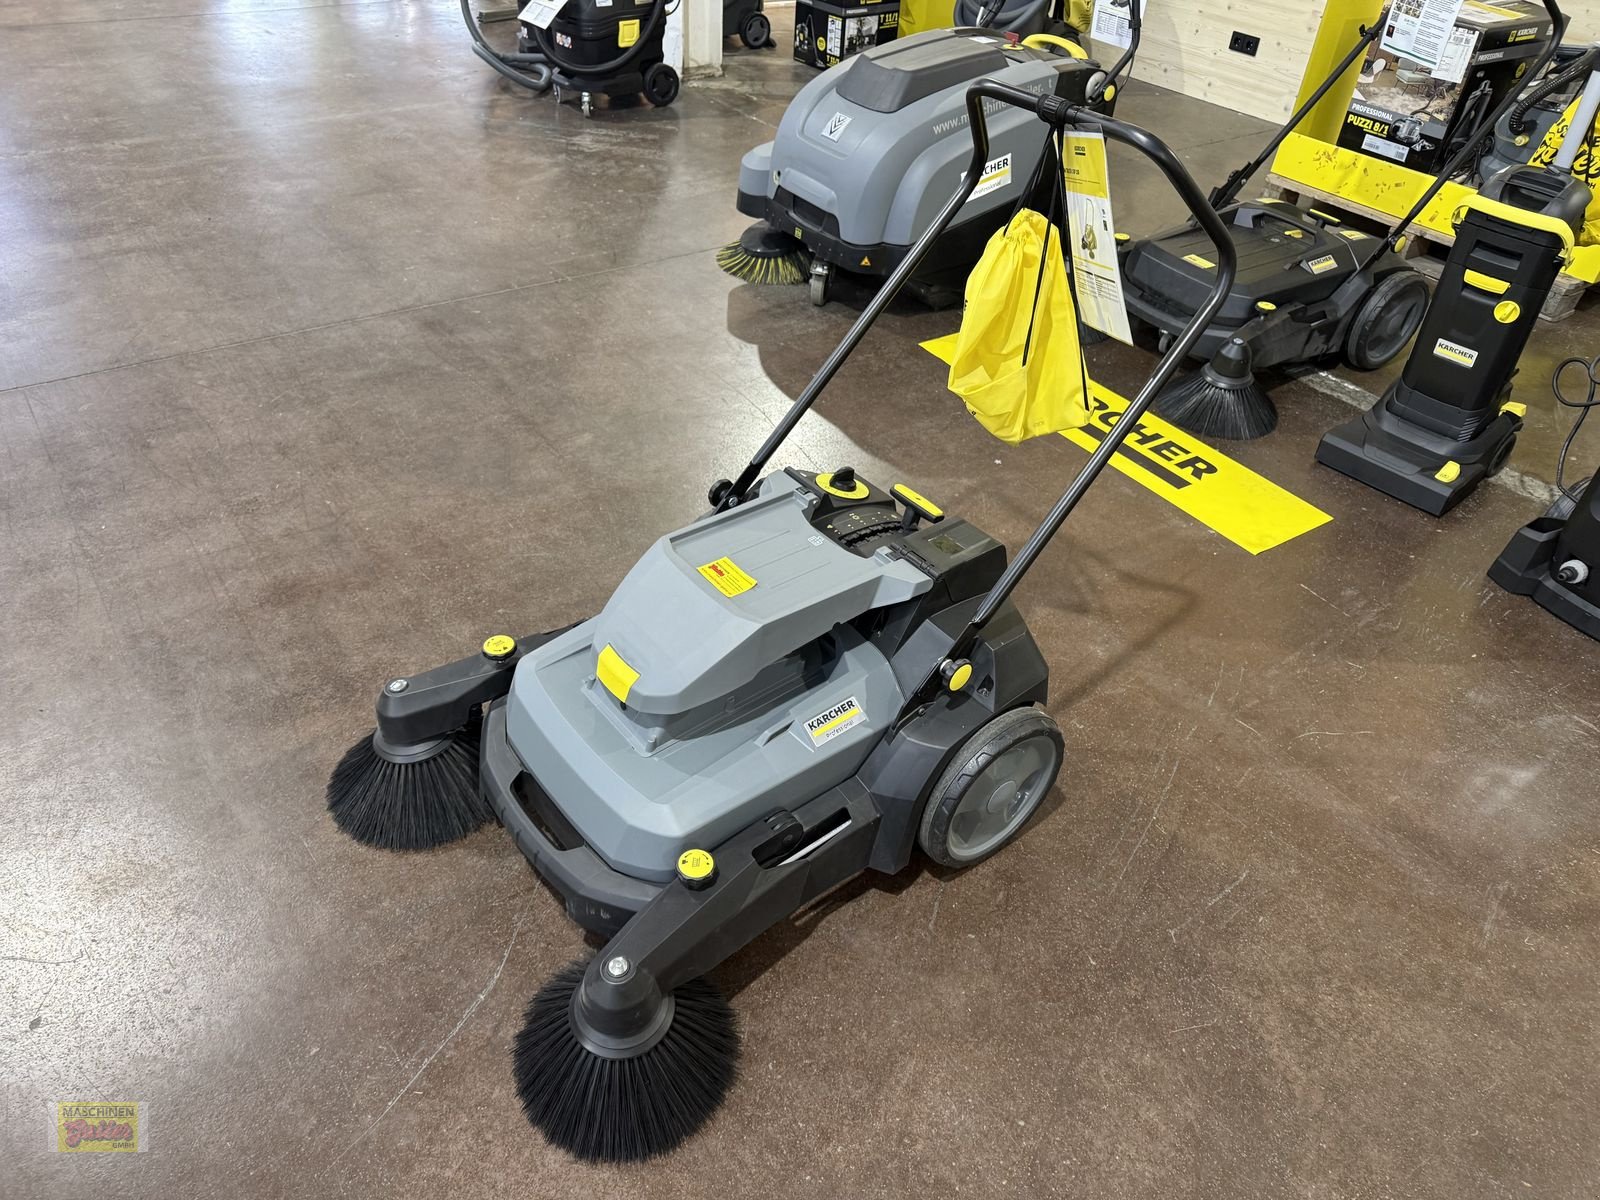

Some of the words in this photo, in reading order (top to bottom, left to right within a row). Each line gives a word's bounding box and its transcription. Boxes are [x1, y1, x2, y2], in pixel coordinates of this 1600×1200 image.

[1352, 103, 1393, 121] PROFESSIONAL
[1347, 114, 1372, 130] PUZZI
[1372, 122, 1389, 135] 8/1
[983, 158, 1009, 175] CHER
[807, 700, 855, 731] KÄRCHER
